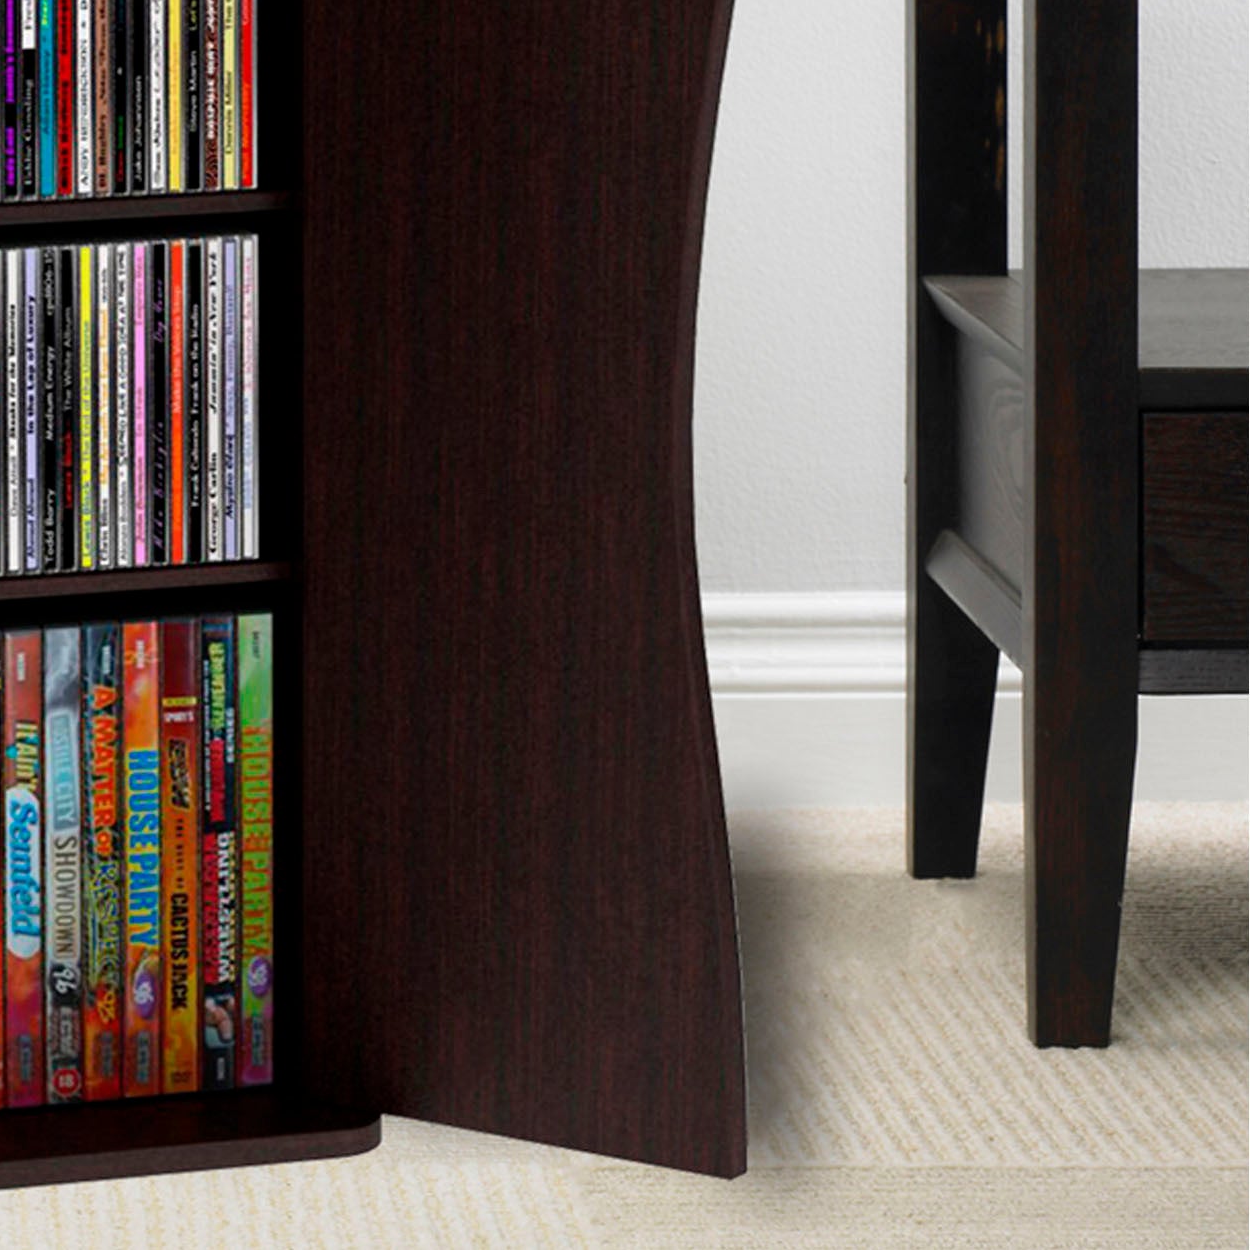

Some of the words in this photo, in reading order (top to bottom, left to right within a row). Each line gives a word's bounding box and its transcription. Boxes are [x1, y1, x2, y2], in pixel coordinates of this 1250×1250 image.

[225, 7, 234, 30] The
[190, 51, 198, 91] Martin
[225, 71, 234, 106] Miller
[225, 110, 234, 154] Dennis
[208, 253, 219, 287] York
[27, 296, 36, 342] Luxury
[64, 307, 72, 347] Album
[27, 365, 36, 389] Lap
[45, 346, 54, 389] Energy
[64, 351, 72, 386] White
[27, 395, 36, 417] the
[45, 393, 54, 440] Medium
[64, 390, 72, 411] The
[208, 452, 219, 498] Carlin
[45, 488, 54, 526] Barry
[208, 503, 219, 553] George
[45, 530, 54, 564] Todd
[93, 684, 117, 710] A
[92, 715, 117, 826] MATTER
[241, 726, 270, 842] HOUSE
[56, 783, 75, 825] CITY
[128, 749, 159, 847] HOUSE
[8, 799, 40, 937] Seinfeld
[54, 835, 78, 958] SHOWDOWN
[128, 852, 159, 947] PARTY
[241, 850, 270, 962] PARTY
[170, 892, 189, 961] CACTUS
[170, 963, 190, 1012] JACK
